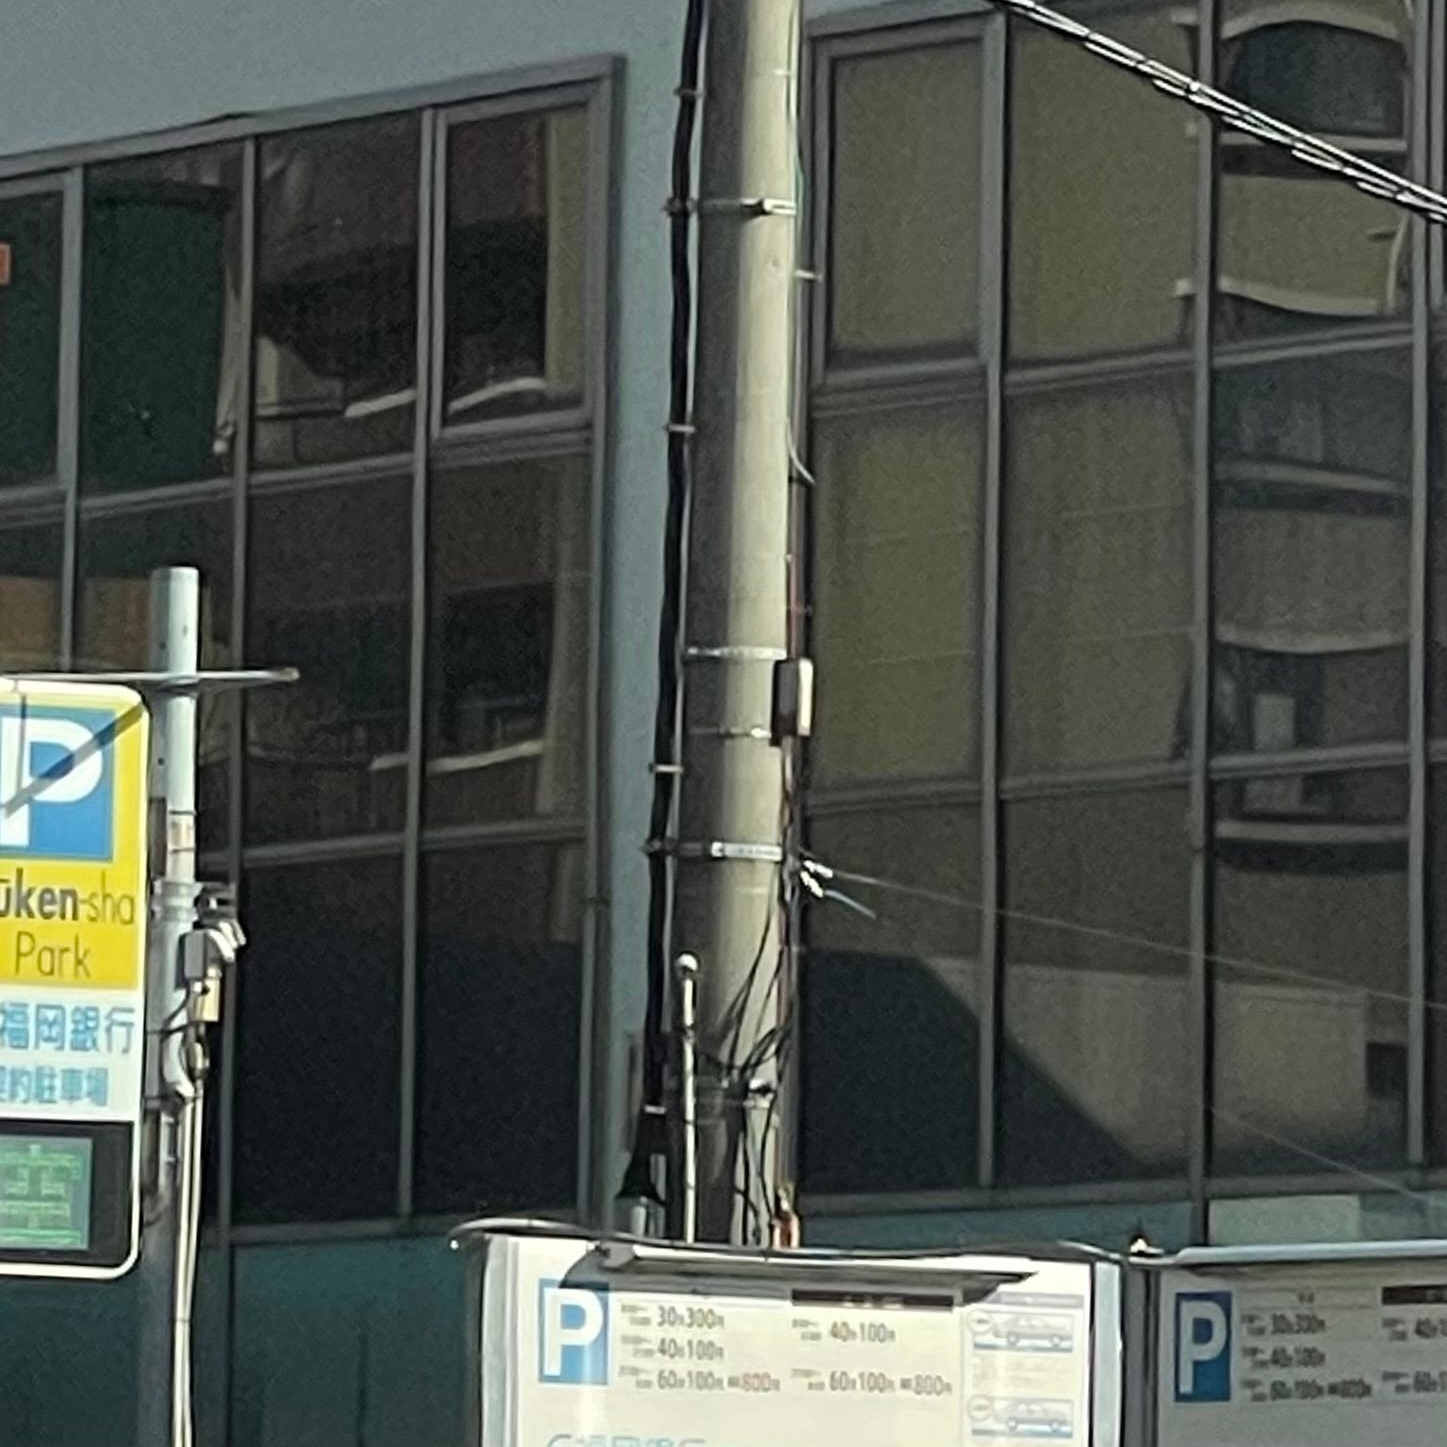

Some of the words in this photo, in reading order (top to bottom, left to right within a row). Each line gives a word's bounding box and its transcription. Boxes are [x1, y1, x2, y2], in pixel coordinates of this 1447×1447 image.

[0, 716, 103, 847] P
[15, 930, 91, 979] Park
[0, 1002, 135, 1054] 福岡銀行
[543, 1288, 604, 1376] P
[1179, 1299, 1227, 1394] P
